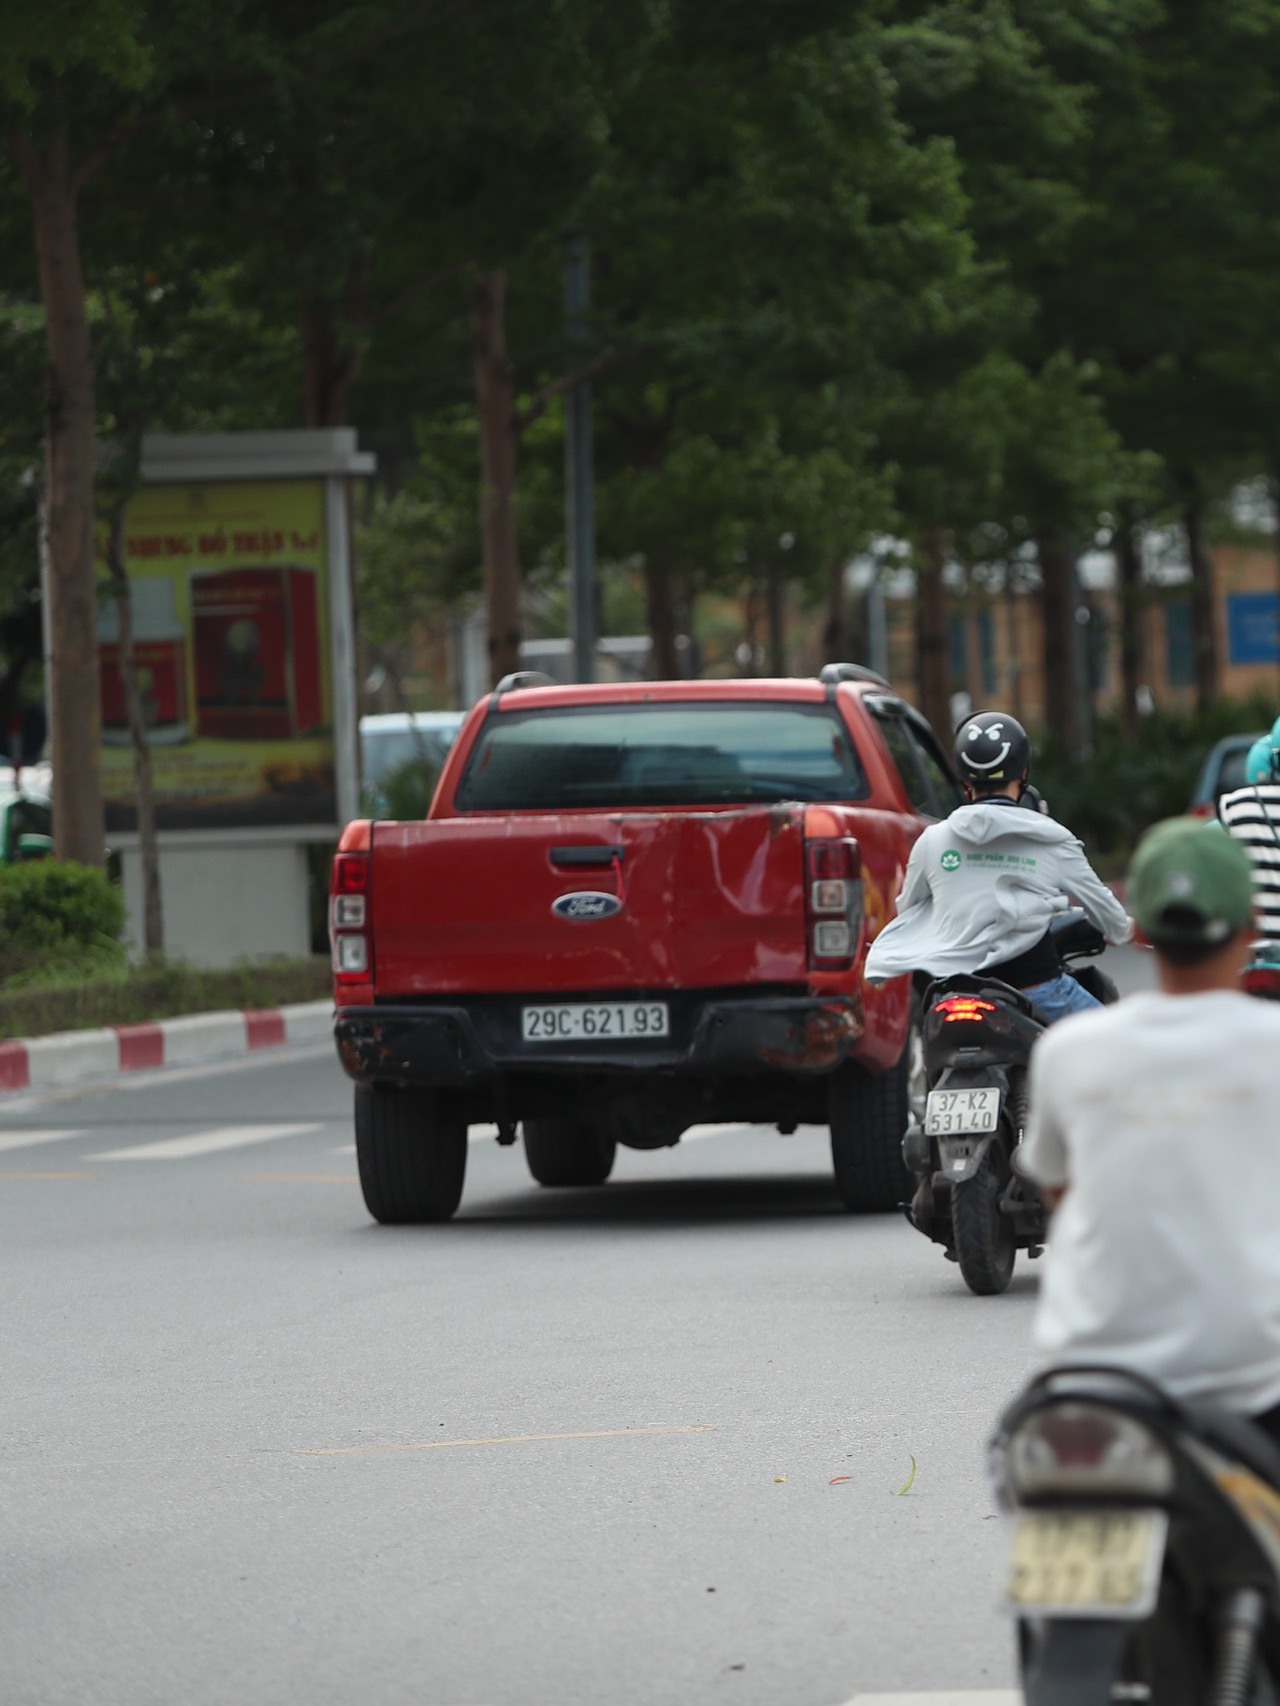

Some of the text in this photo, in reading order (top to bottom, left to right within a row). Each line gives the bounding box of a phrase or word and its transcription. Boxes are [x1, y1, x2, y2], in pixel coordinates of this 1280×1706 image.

[566, 897, 606, 916] Ford
[526, 1006, 665, 1037] 29C-621.93
[938, 1091, 988, 1112] 37-K2
[931, 1112, 992, 1133] 531.40
